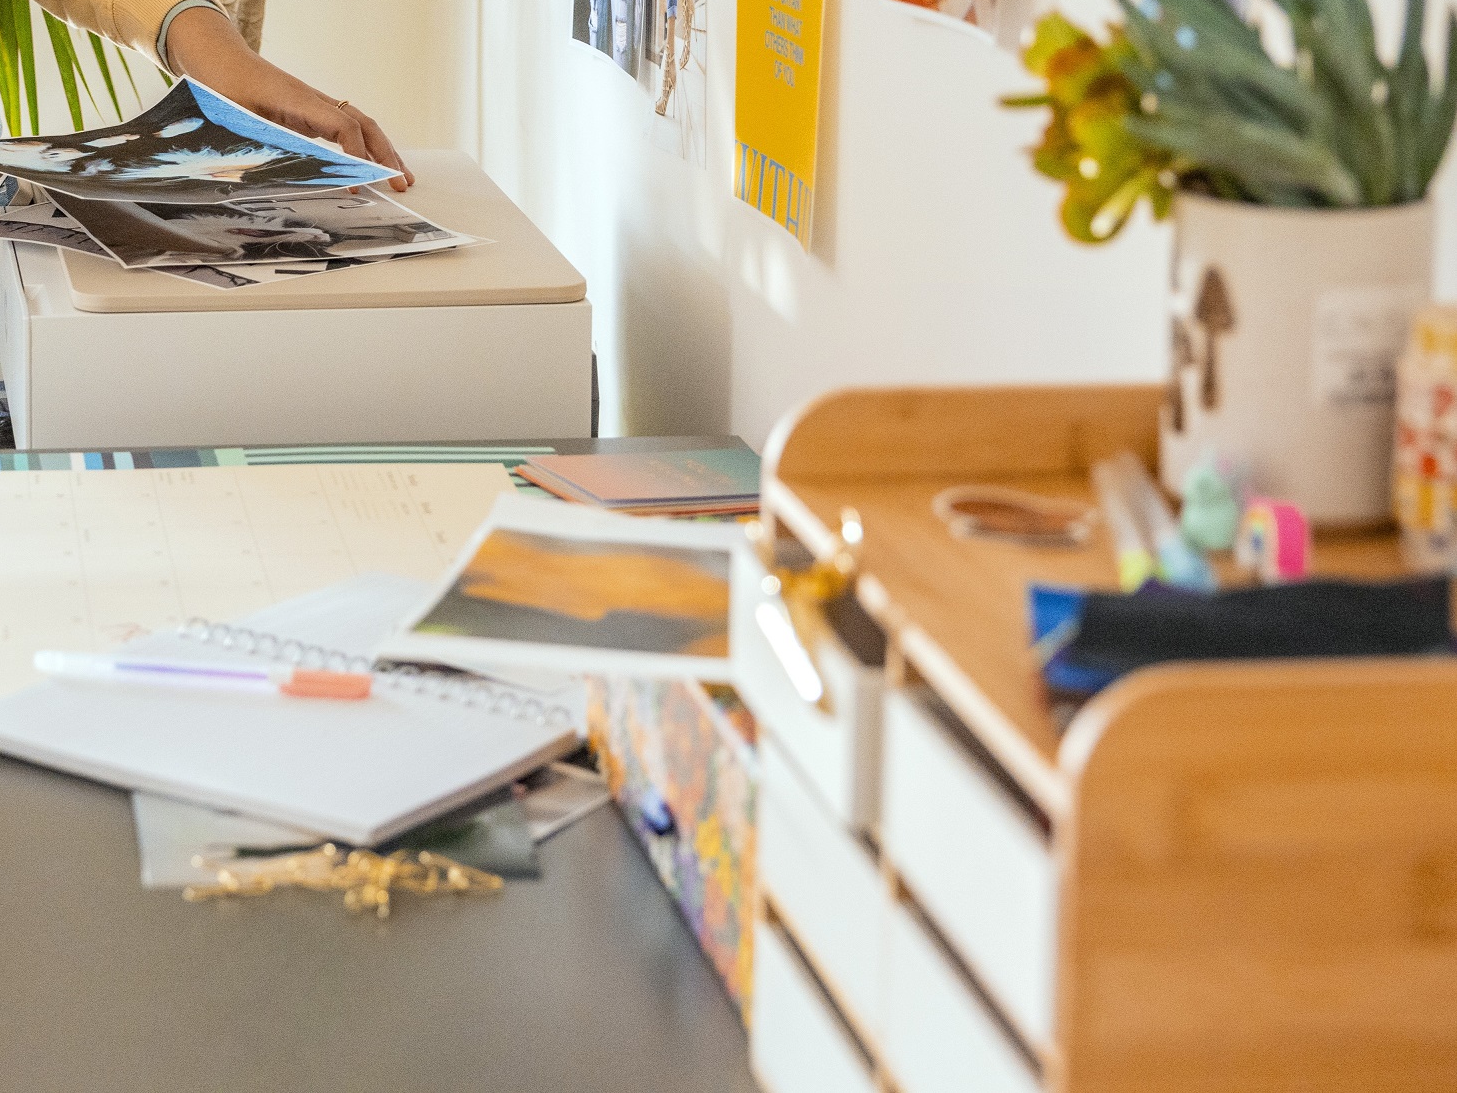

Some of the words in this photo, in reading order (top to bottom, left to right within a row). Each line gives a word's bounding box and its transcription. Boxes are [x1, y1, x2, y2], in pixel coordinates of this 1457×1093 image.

[769, 6, 785, 29] THAN
[786, 15, 803, 38] WHAT
[765, 30, 788, 58] OTHERS
[773, 60, 782, 79] OF
[783, 64, 795, 88] YOU
